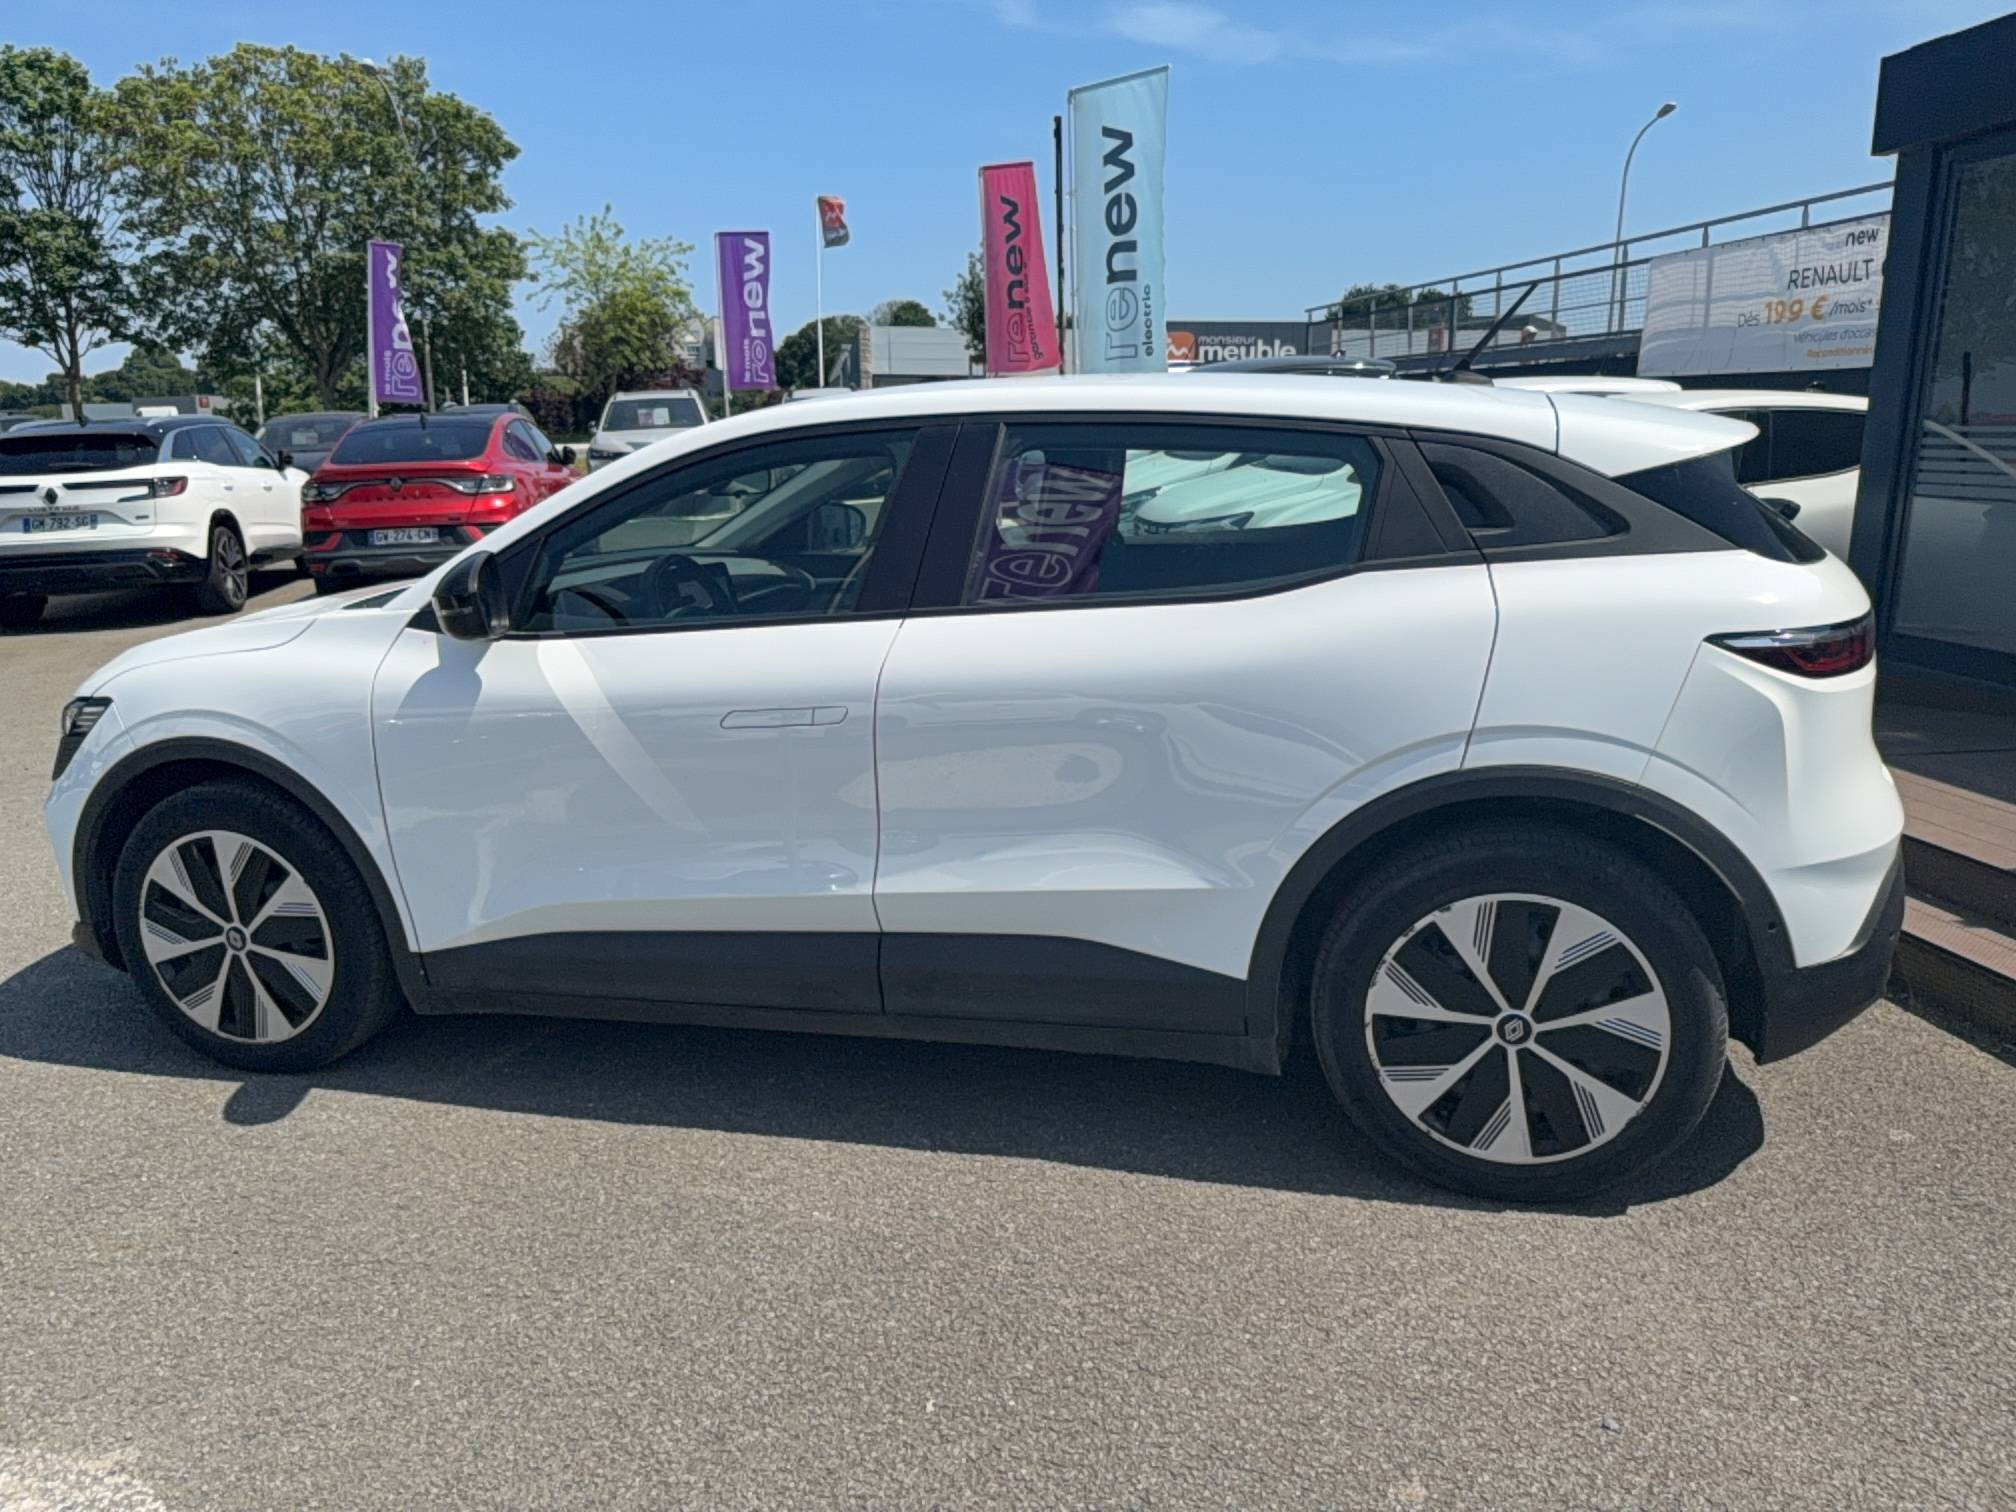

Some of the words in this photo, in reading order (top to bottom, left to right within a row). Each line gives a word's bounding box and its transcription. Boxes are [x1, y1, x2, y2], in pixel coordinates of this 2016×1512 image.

[1101, 125, 1139, 361] renew
[1845, 228, 1880, 247] new
[1001, 196, 1030, 362] renew
[1787, 258, 1874, 290] RENAULT
[743, 238, 769, 383] renew
[1142, 284, 1155, 357] electric
[1764, 298, 1805, 325] 199
[1810, 294, 1830, 321] €
[1198, 335, 1256, 345] monsieur
[1199, 338, 1297, 362] meuble
